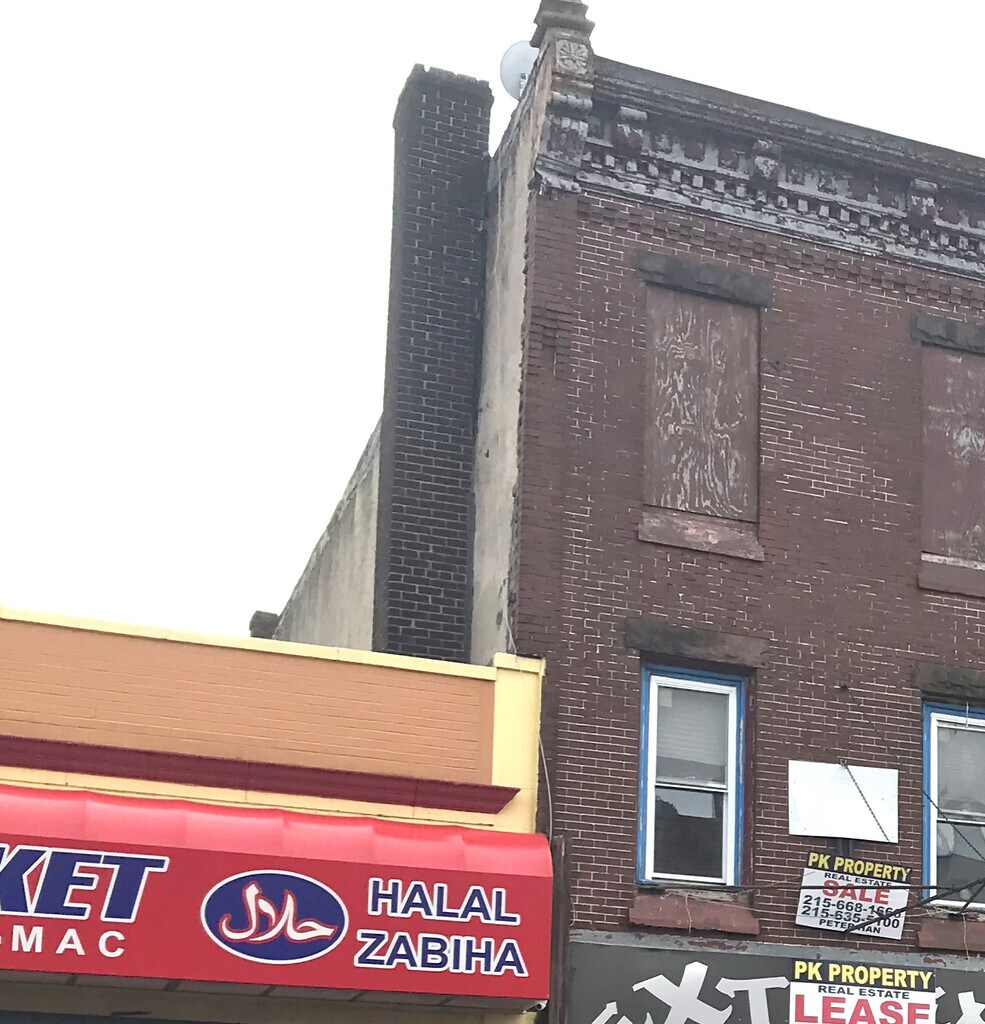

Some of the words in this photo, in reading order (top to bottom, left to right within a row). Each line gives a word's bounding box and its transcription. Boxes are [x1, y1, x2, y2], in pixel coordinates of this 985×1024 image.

[808, 852, 831, 870] PK
[833, 857, 911, 882] PROPERTY
[824, 872, 851, 882] REAL
[855, 877, 892, 887] ESTATE
[367, 877, 520, 926] HALAL
[822, 879, 890, 905] SALE
[219, 882, 338, 943] حلال
[353, 932, 529, 977] ZABIHA
[794, 960, 823, 981] PK
[829, 963, 933, 990] PROPERTY
[818, 985, 854, 996] REAL
[858, 988, 910, 1000] ESTATE
